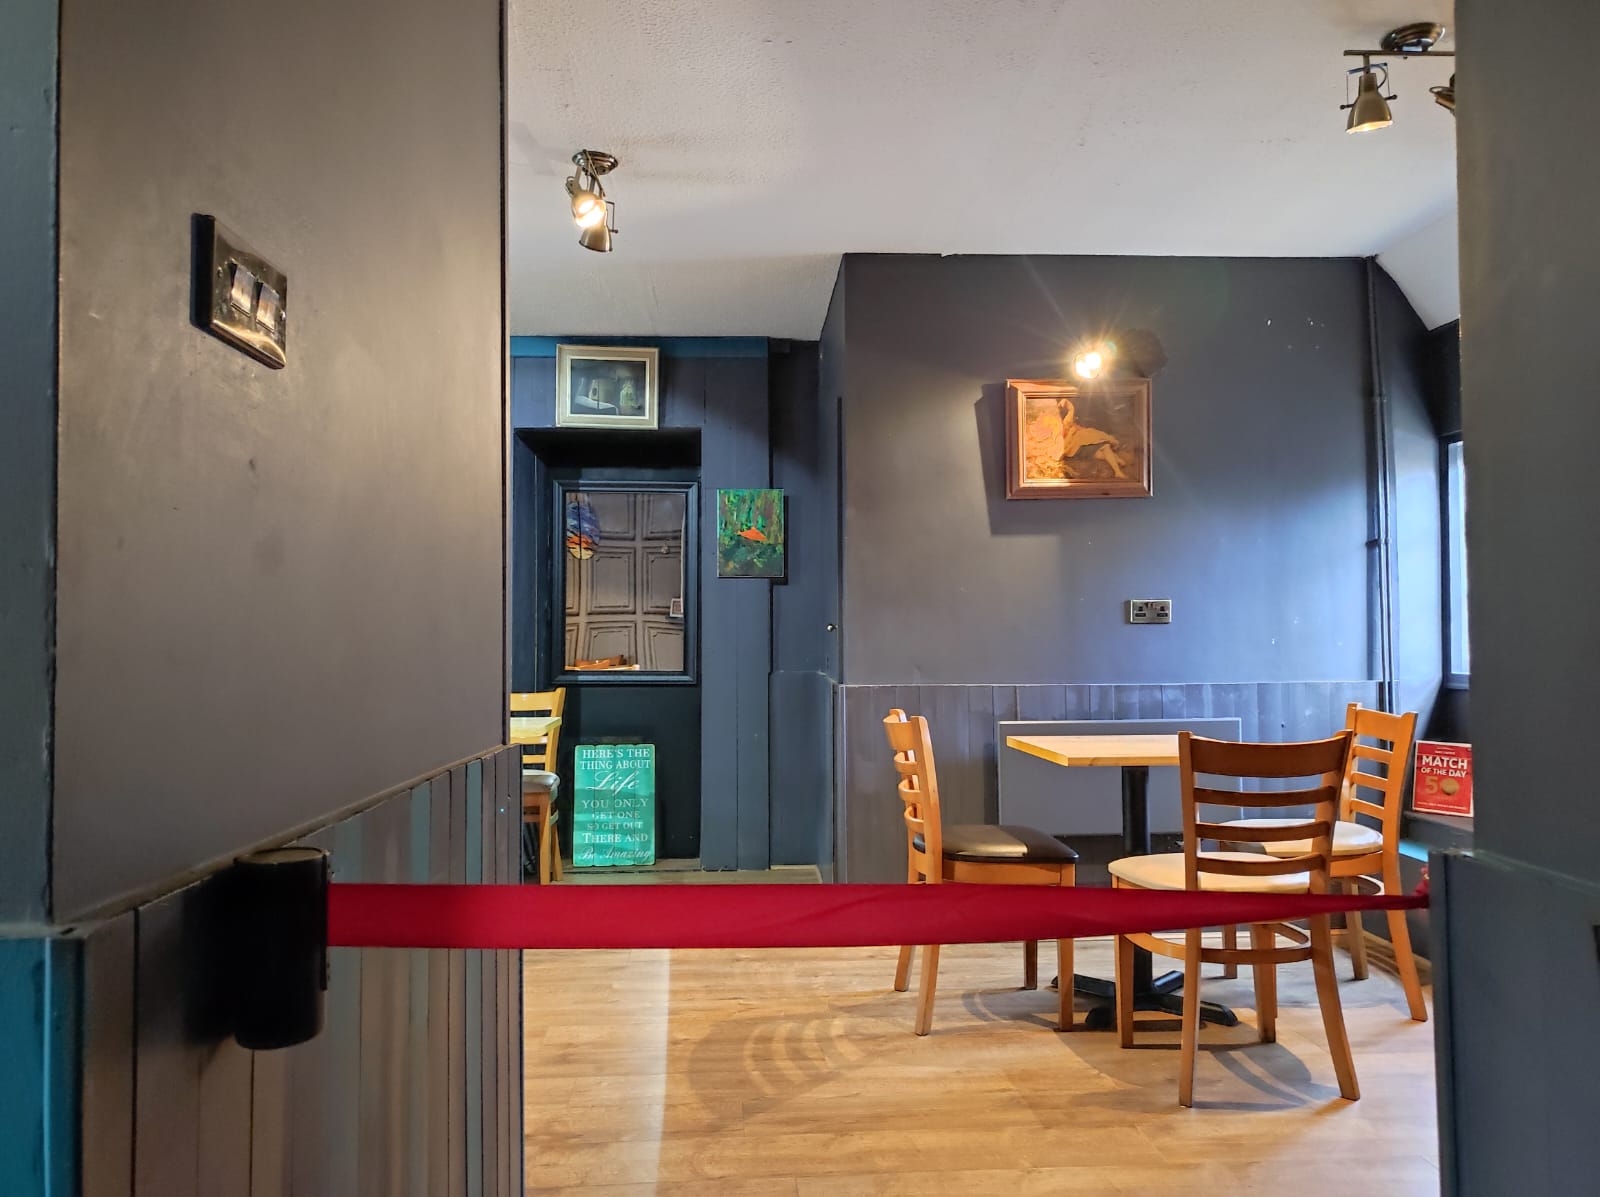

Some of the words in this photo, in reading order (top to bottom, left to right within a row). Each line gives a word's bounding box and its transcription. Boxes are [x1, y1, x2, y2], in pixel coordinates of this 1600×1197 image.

[583, 749, 624, 759] HERE'S
[627, 748, 650, 758] THE
[580, 760, 613, 770] THING
[615, 759, 651, 769] ABOUT
[1422, 755, 1468, 769] MATCH
[585, 770, 640, 797] Life
[582, 799, 609, 809] YOU
[614, 798, 649, 808] ONLY
[617, 810, 641, 819] ONE
[601, 822, 620, 830] GET
[623, 821, 643, 829] OUT
[604, 845, 652, 861] Amazing
